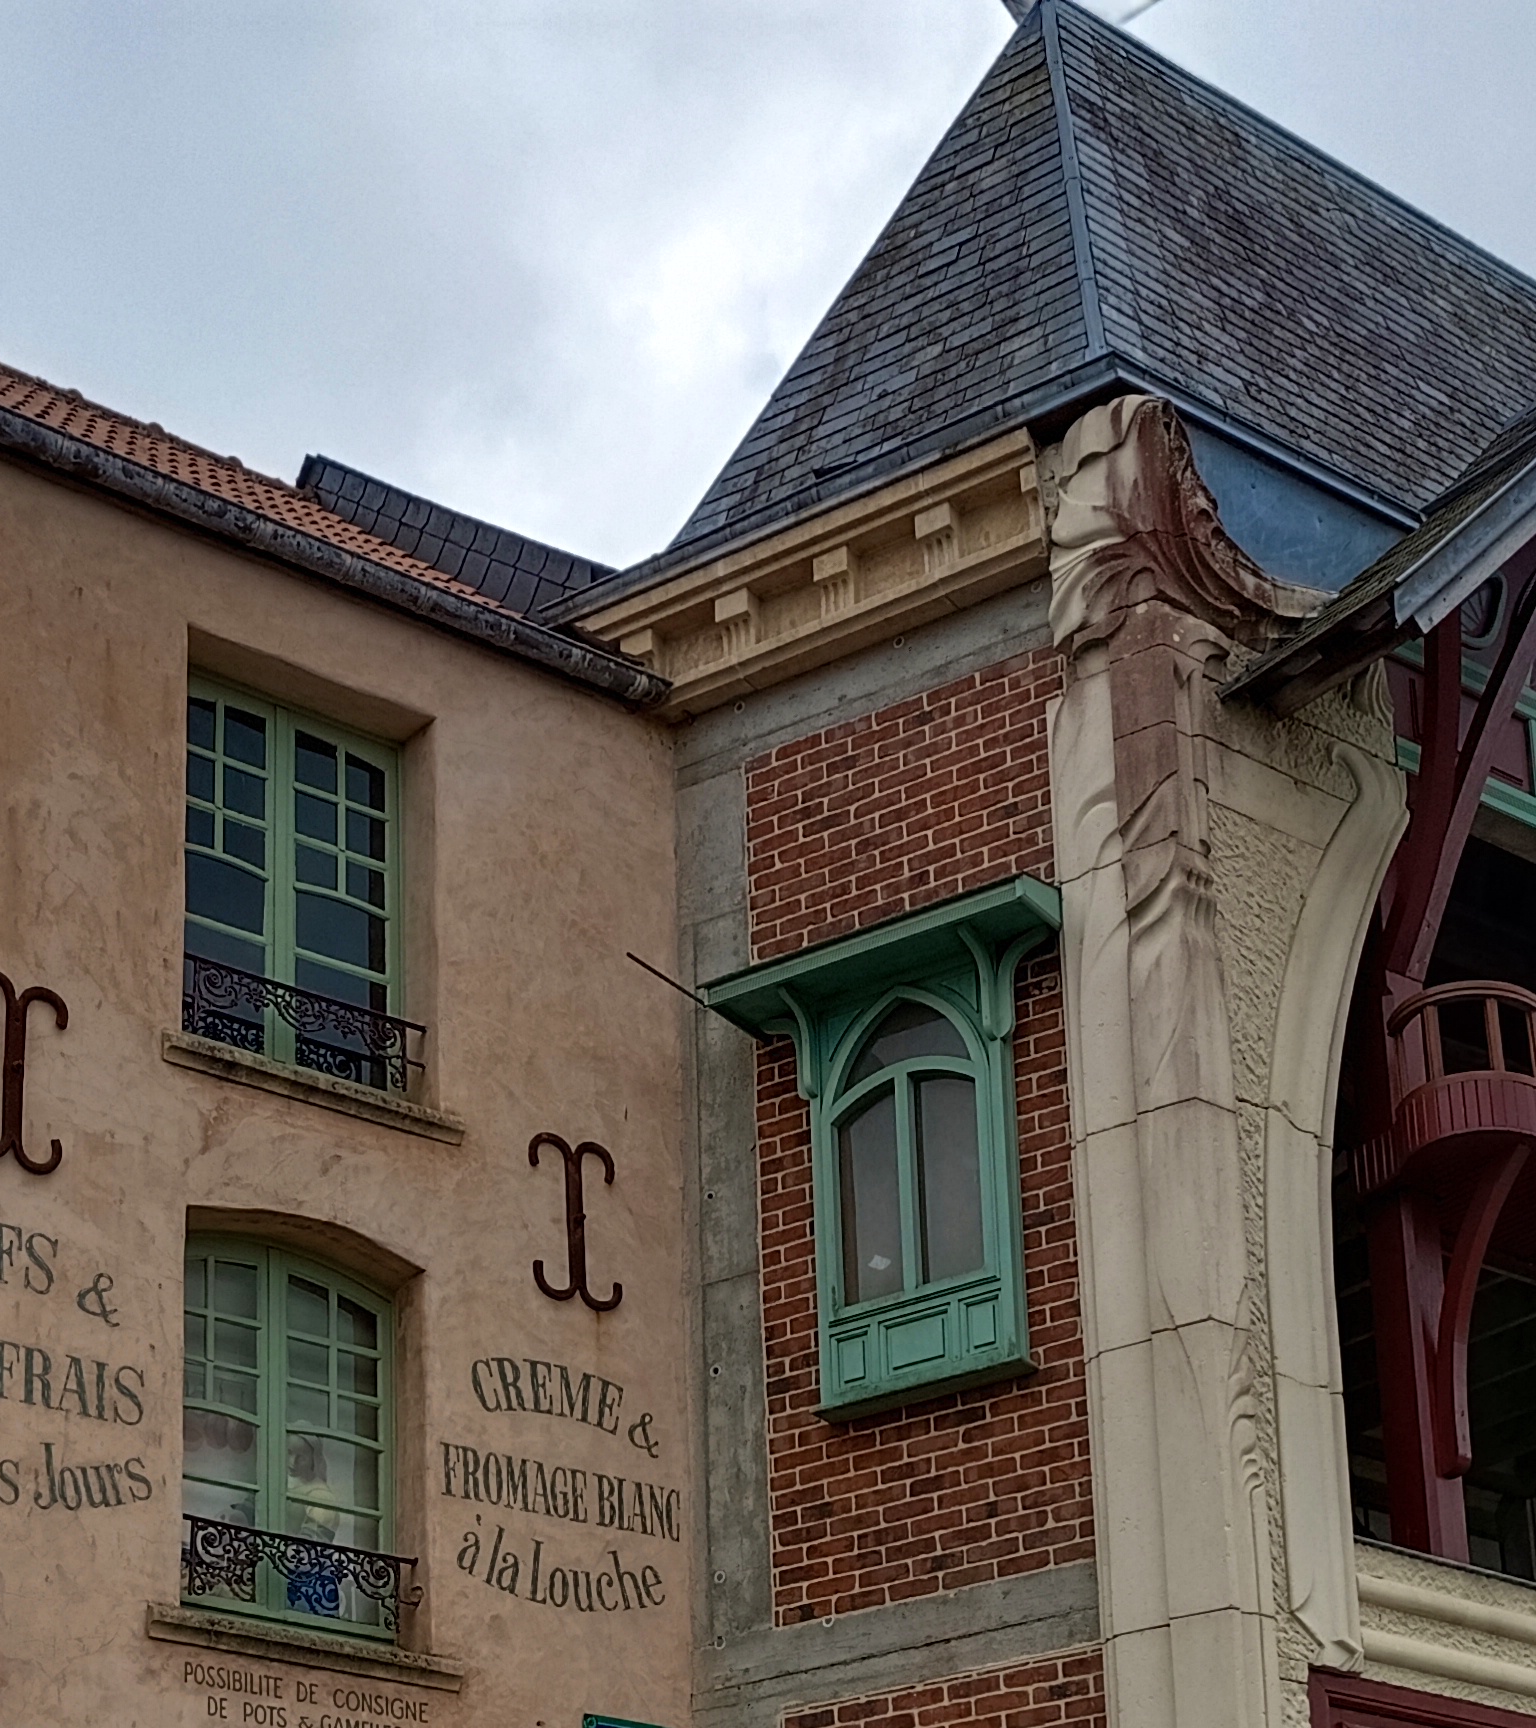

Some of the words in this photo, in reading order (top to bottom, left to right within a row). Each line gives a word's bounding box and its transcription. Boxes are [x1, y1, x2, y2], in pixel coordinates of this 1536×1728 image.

[76, 1272, 121, 1327] &
[470, 1357, 624, 1435] CREME
[627, 1412, 660, 1459] &
[33, 1441, 154, 1512] Jours
[439, 1441, 589, 1524] FROMAGE
[591, 1472, 681, 1544] BLANC
[455, 1513, 483, 1578] à
[482, 1524, 520, 1598] la
[524, 1537, 667, 1613] Louche
[184, 1661, 284, 1700] POSSIBILITE
[296, 1680, 320, 1705] DE
[332, 1688, 430, 1724] CONSIGNE
[207, 1695, 229, 1719] DE
[242, 1701, 288, 1728] POTS
